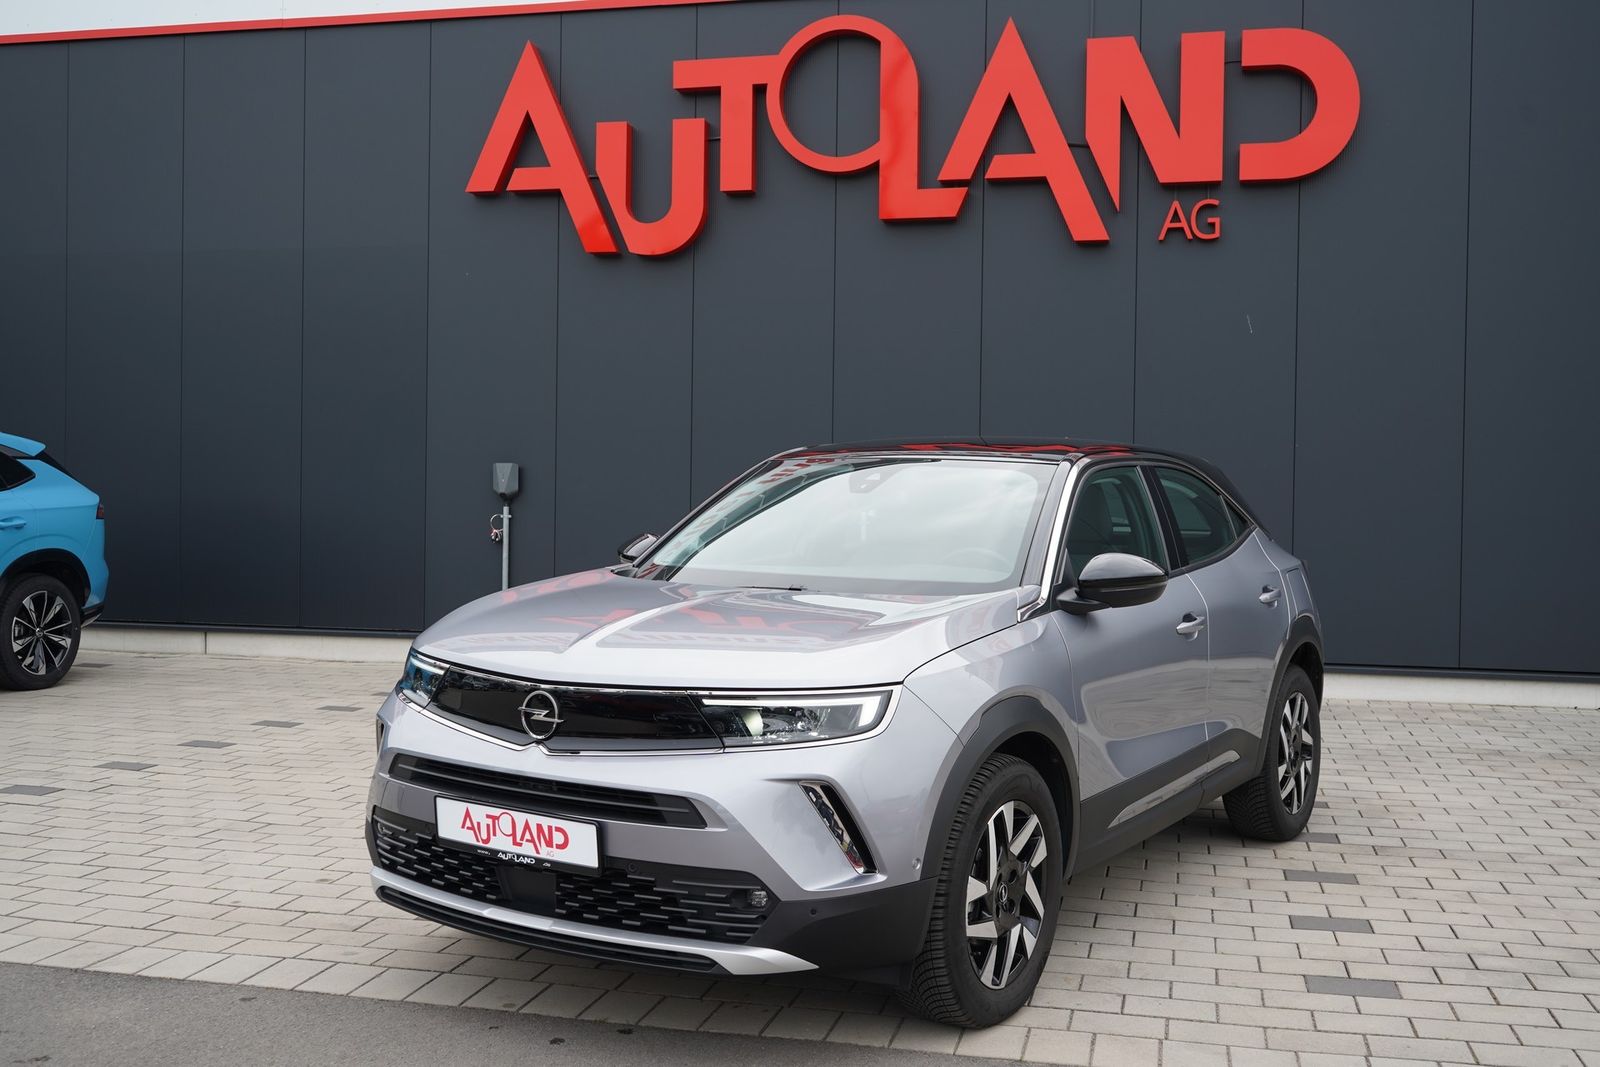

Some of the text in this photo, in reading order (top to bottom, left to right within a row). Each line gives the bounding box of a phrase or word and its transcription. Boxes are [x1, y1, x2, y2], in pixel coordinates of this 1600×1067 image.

[466, 15, 1361, 256] AUTOLAND
[1159, 199, 1221, 241] AG
[461, 807, 569, 854] AUTOLAND
[497, 852, 535, 864] AUTOLAND
